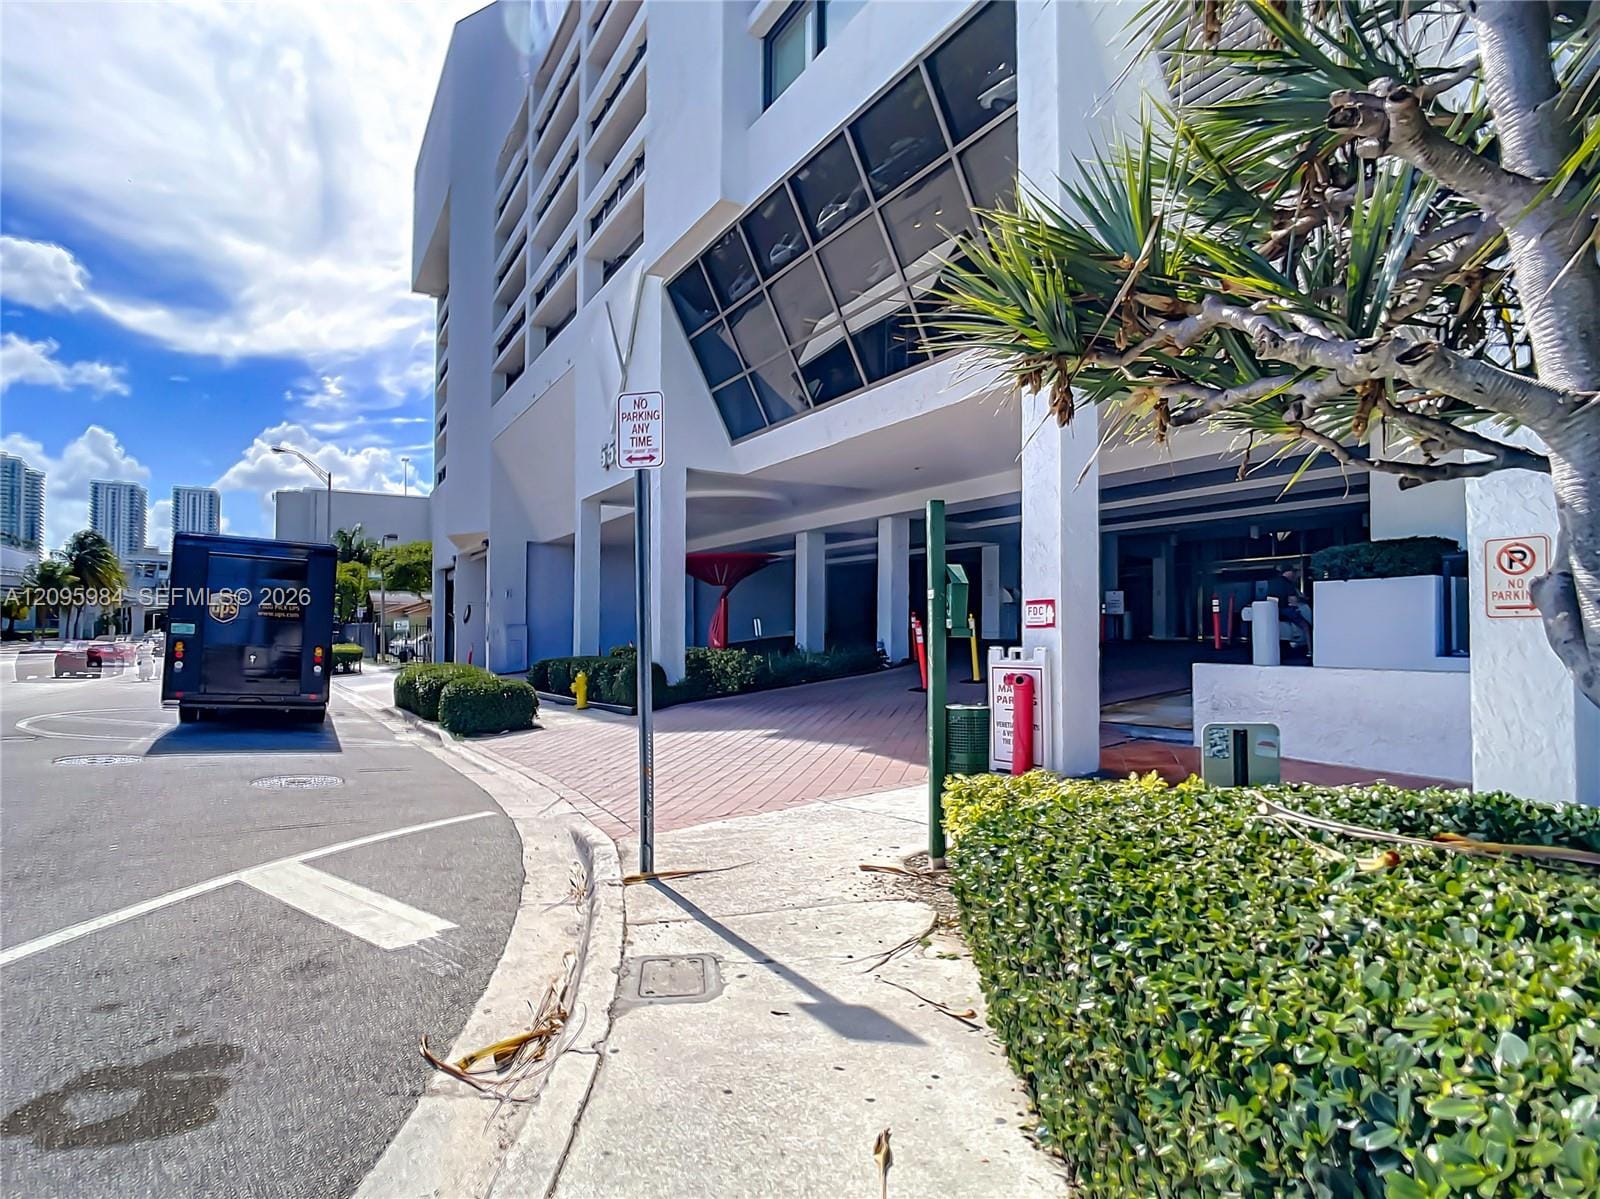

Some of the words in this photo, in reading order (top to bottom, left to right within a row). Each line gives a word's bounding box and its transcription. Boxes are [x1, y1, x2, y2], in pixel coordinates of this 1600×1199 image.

[633, 398, 648, 410] NO
[621, 410, 660, 423] PARKING
[631, 423, 650, 434] ANY
[630, 435, 653, 448] TIME
[1508, 579, 1524, 589] NO
[1491, 590, 1532, 601] PARKIN
[1027, 606, 1044, 616] FDC
